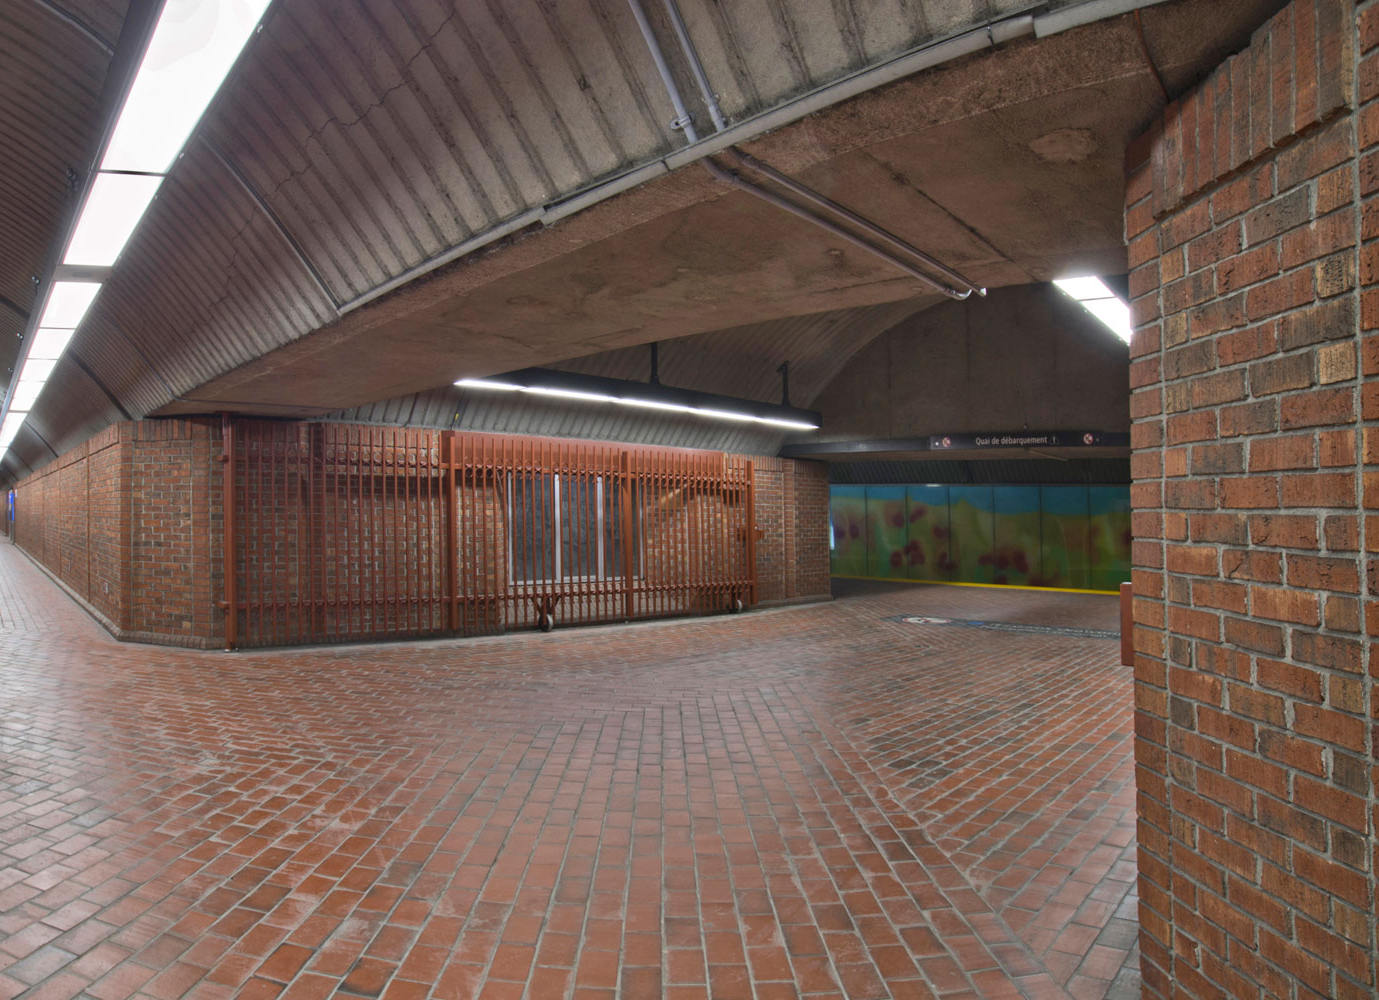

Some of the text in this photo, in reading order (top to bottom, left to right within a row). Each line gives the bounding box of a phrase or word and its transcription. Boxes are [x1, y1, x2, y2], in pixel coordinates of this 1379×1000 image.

[975, 435, 1048, 446] Quai de débarquement
